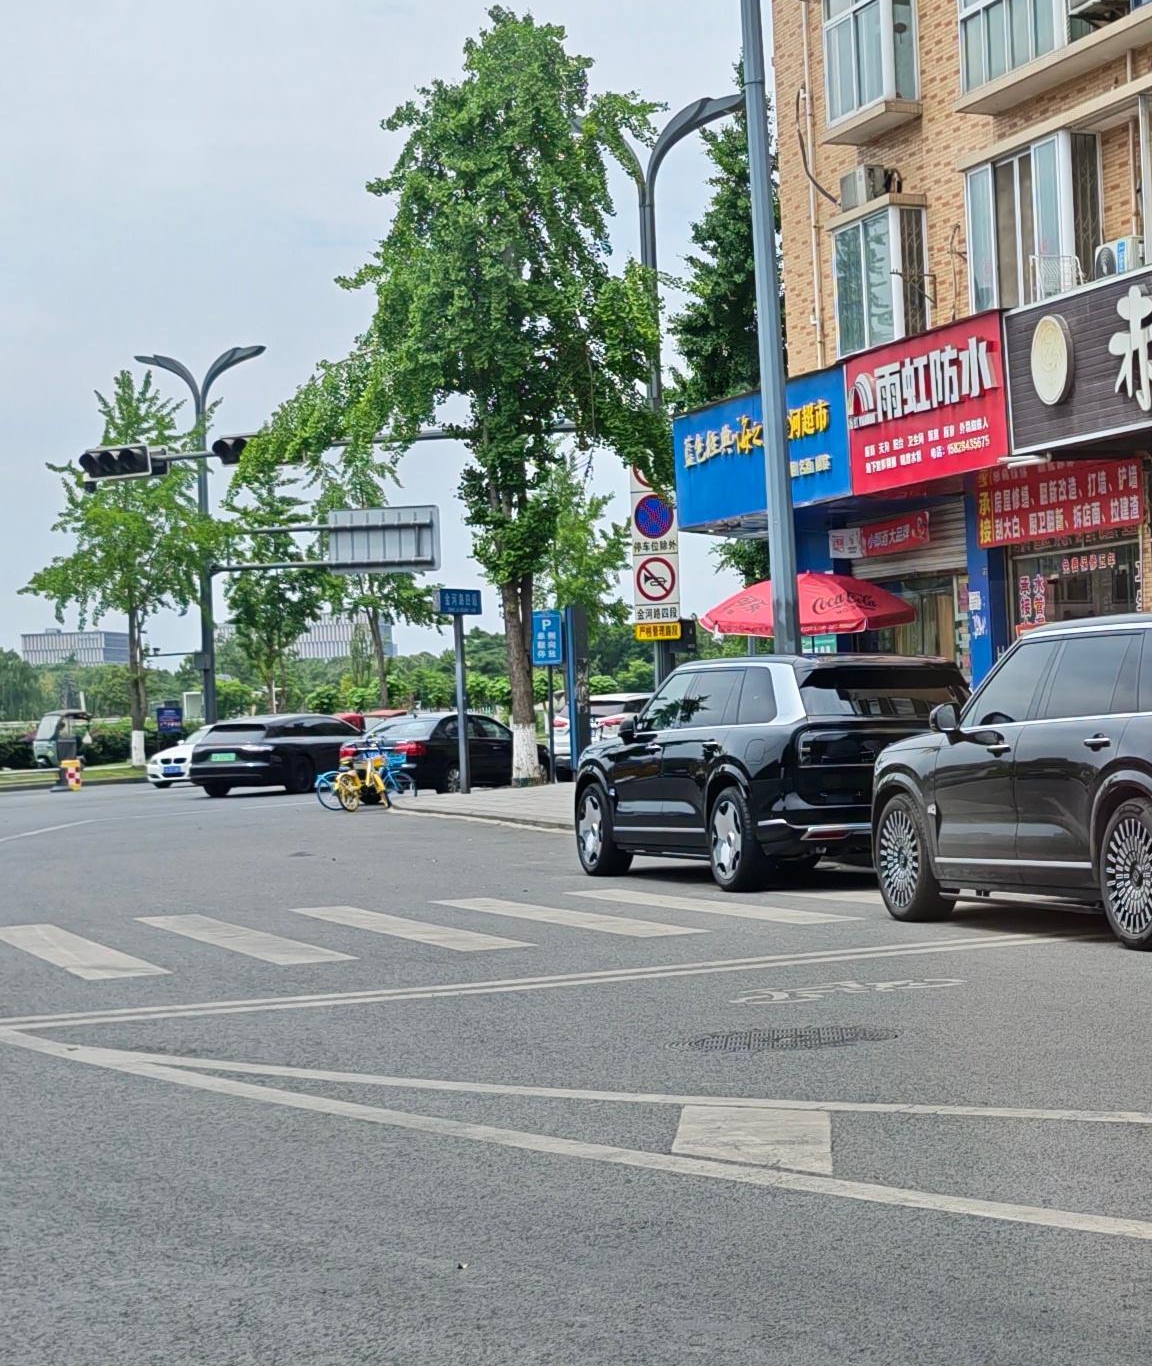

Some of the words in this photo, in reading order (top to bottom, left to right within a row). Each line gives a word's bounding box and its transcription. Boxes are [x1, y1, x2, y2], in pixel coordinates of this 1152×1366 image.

[874, 336, 993, 422] 雨虹防水
[634, 540, 677, 552] 停车位除外
[444, 593, 478, 607] 金河路四段
[637, 608, 678, 620] 金河路四段
[542, 619, 552, 631] P
